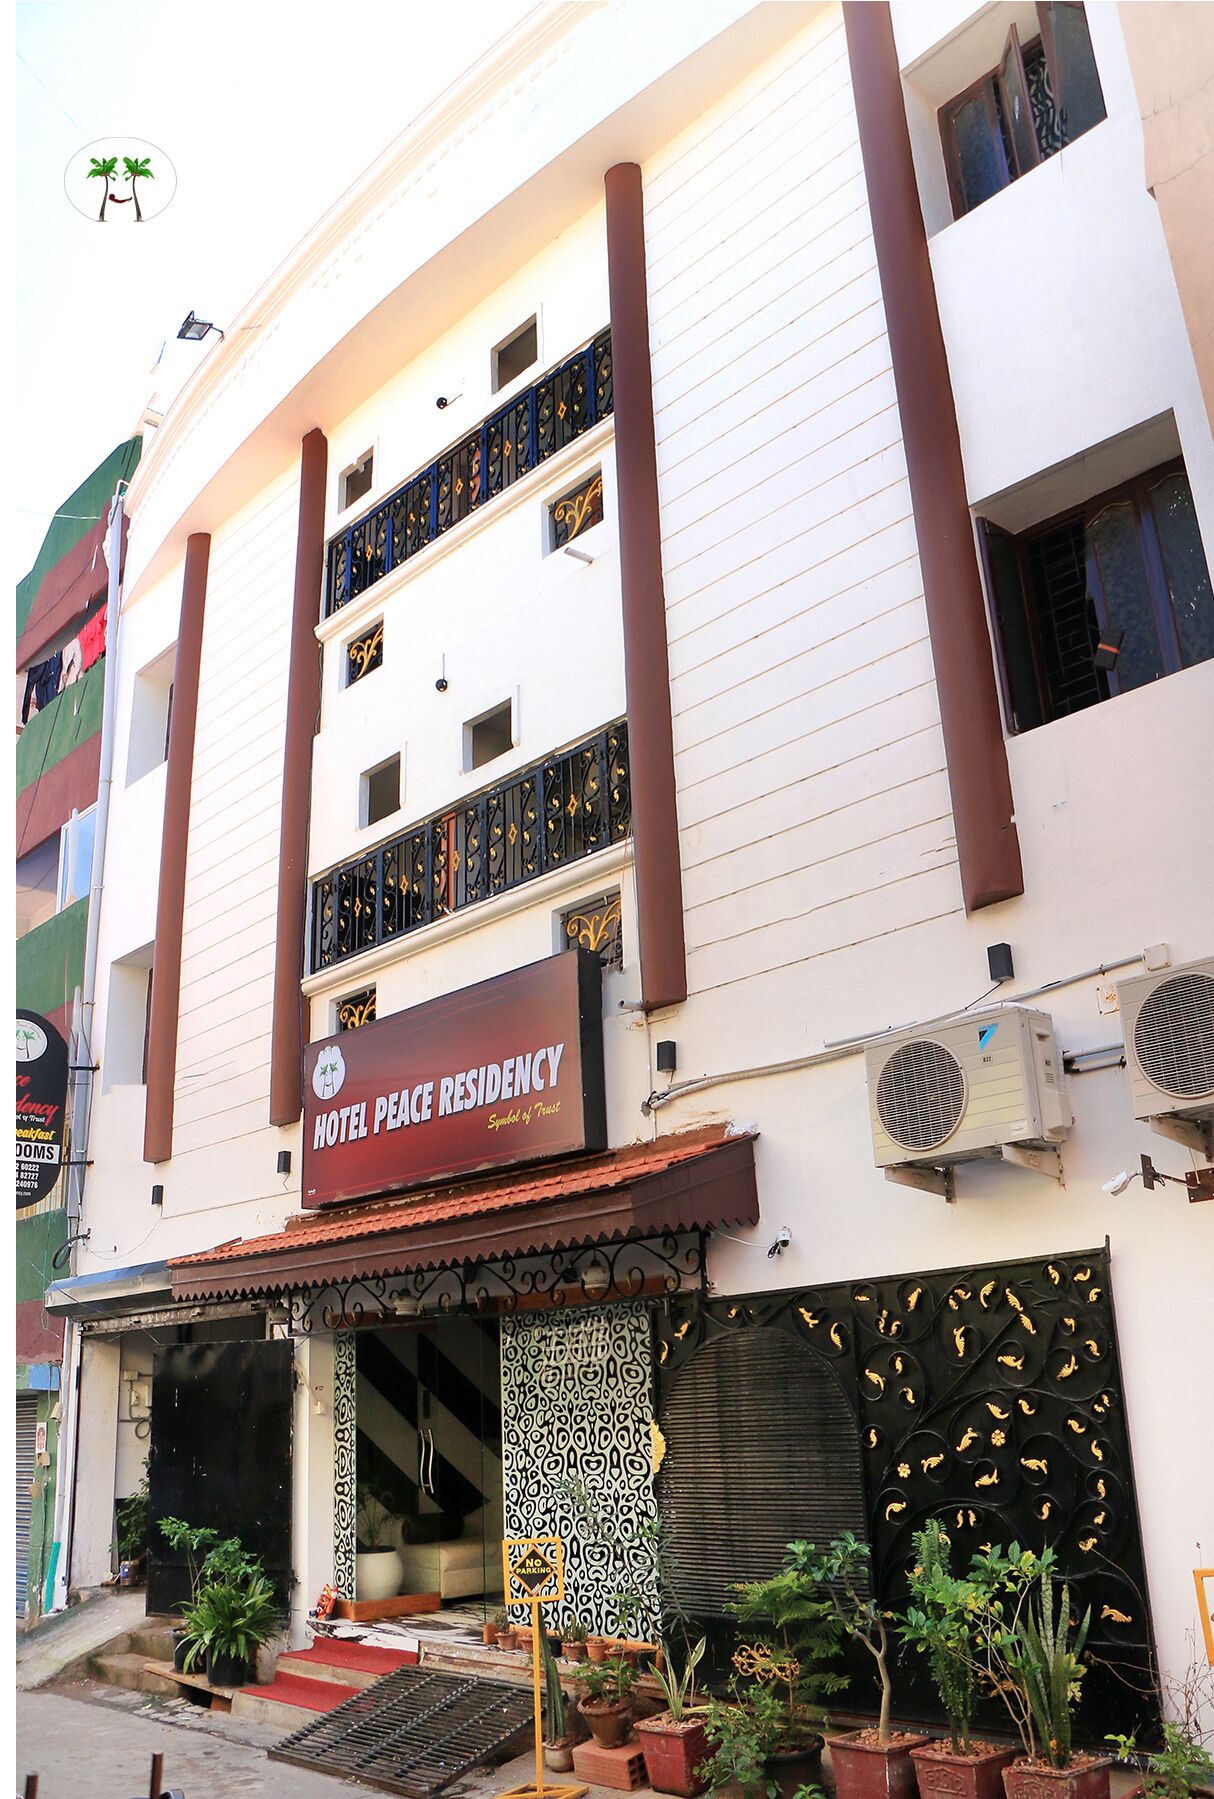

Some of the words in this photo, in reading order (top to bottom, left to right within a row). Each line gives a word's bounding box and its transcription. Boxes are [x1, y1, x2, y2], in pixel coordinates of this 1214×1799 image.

[313, 1101, 368, 1151] HOTEL
[373, 1081, 434, 1134] PEACE
[438, 1043, 565, 1117] RESIDENCY
[28, 1114, 46, 1123] Trust
[487, 1109, 521, 1131] Symbol
[521, 1106, 533, 1125] of
[534, 1100, 561, 1118] Trust
[525, 1558, 542, 1567] NO
[515, 1567, 552, 1575] PARKING
